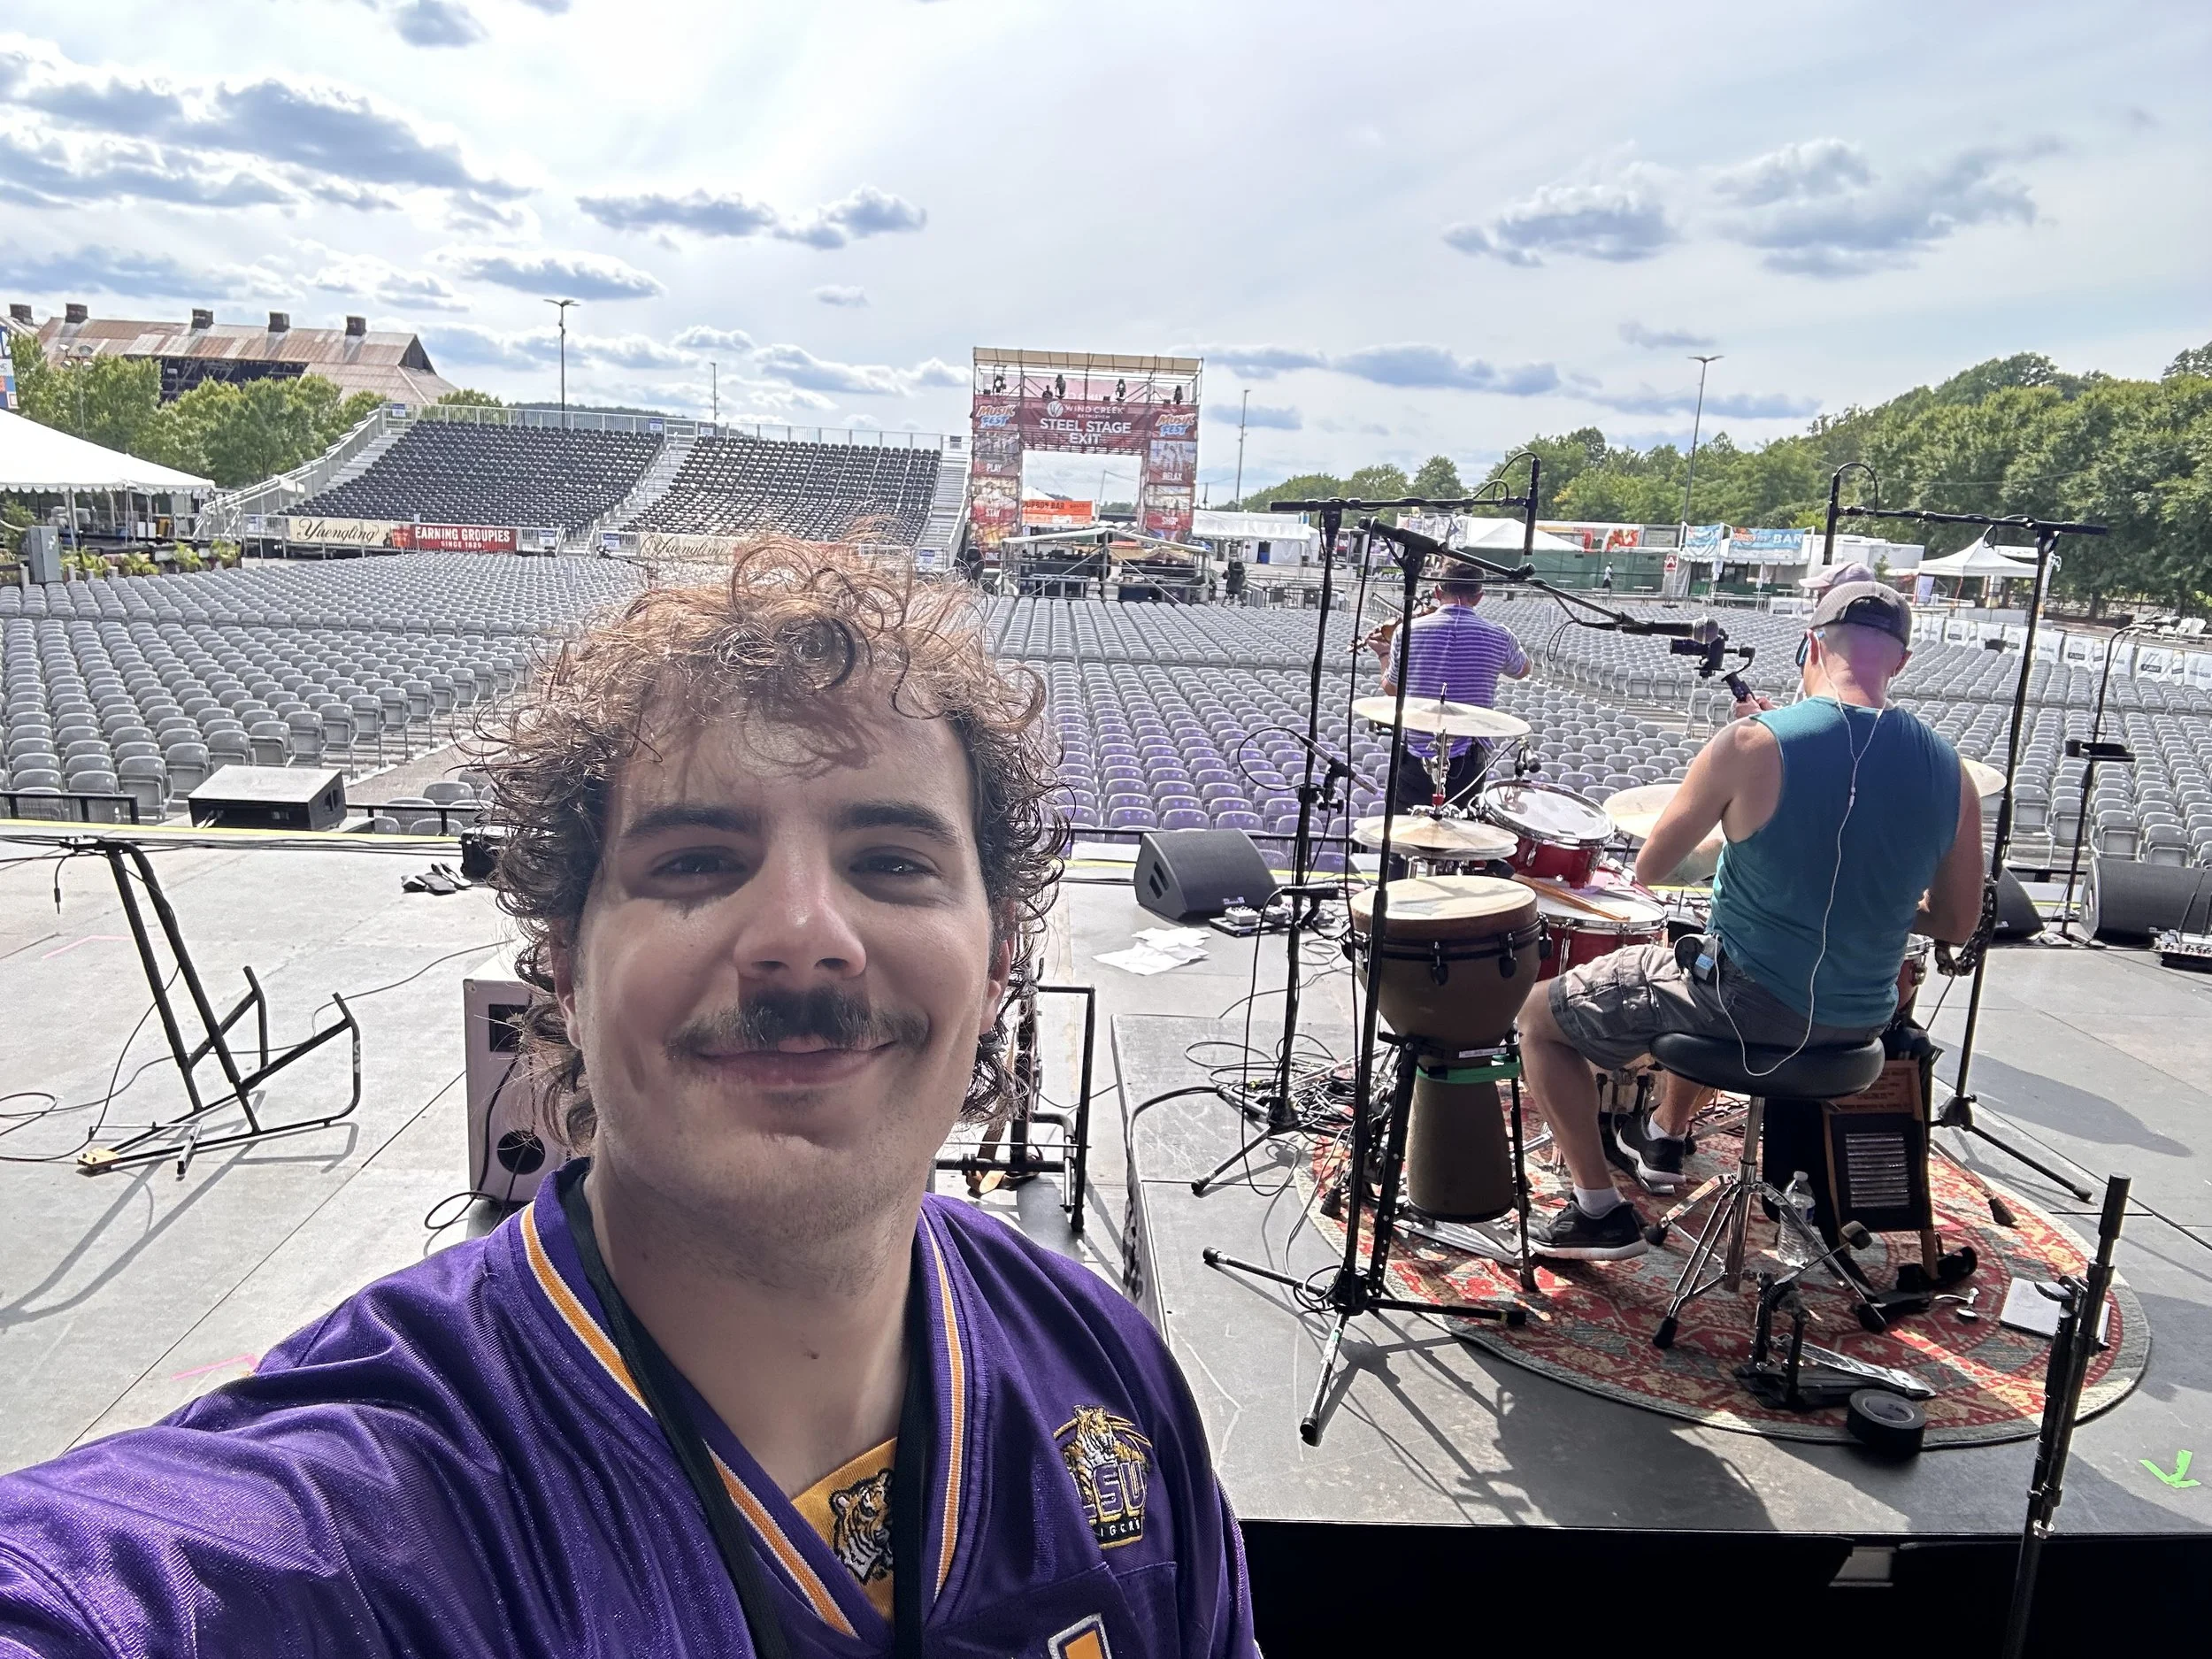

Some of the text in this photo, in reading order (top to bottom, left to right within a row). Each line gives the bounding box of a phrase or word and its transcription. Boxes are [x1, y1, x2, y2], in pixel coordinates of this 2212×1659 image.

[976, 405, 1017, 417] MUSIK
[1064, 404, 1125, 414] WIND CREEK
[980, 416, 1009, 428] FEST
[1040, 418, 1132, 434] STEEL STAGE
[1160, 425, 1189, 437] FEST
[1069, 432, 1102, 444] EXIT
[986, 463, 1002, 472] PLAY
[1162, 472, 1182, 481] RELAX
[986, 508, 1001, 517] STAY
[296, 518, 380, 543] Yuengling
[415, 526, 459, 541] EARNING
[461, 528, 511, 542] GROUPIES
[1772, 534, 1801, 544] BAR
[1099, 1517, 1141, 1537] IGERS
